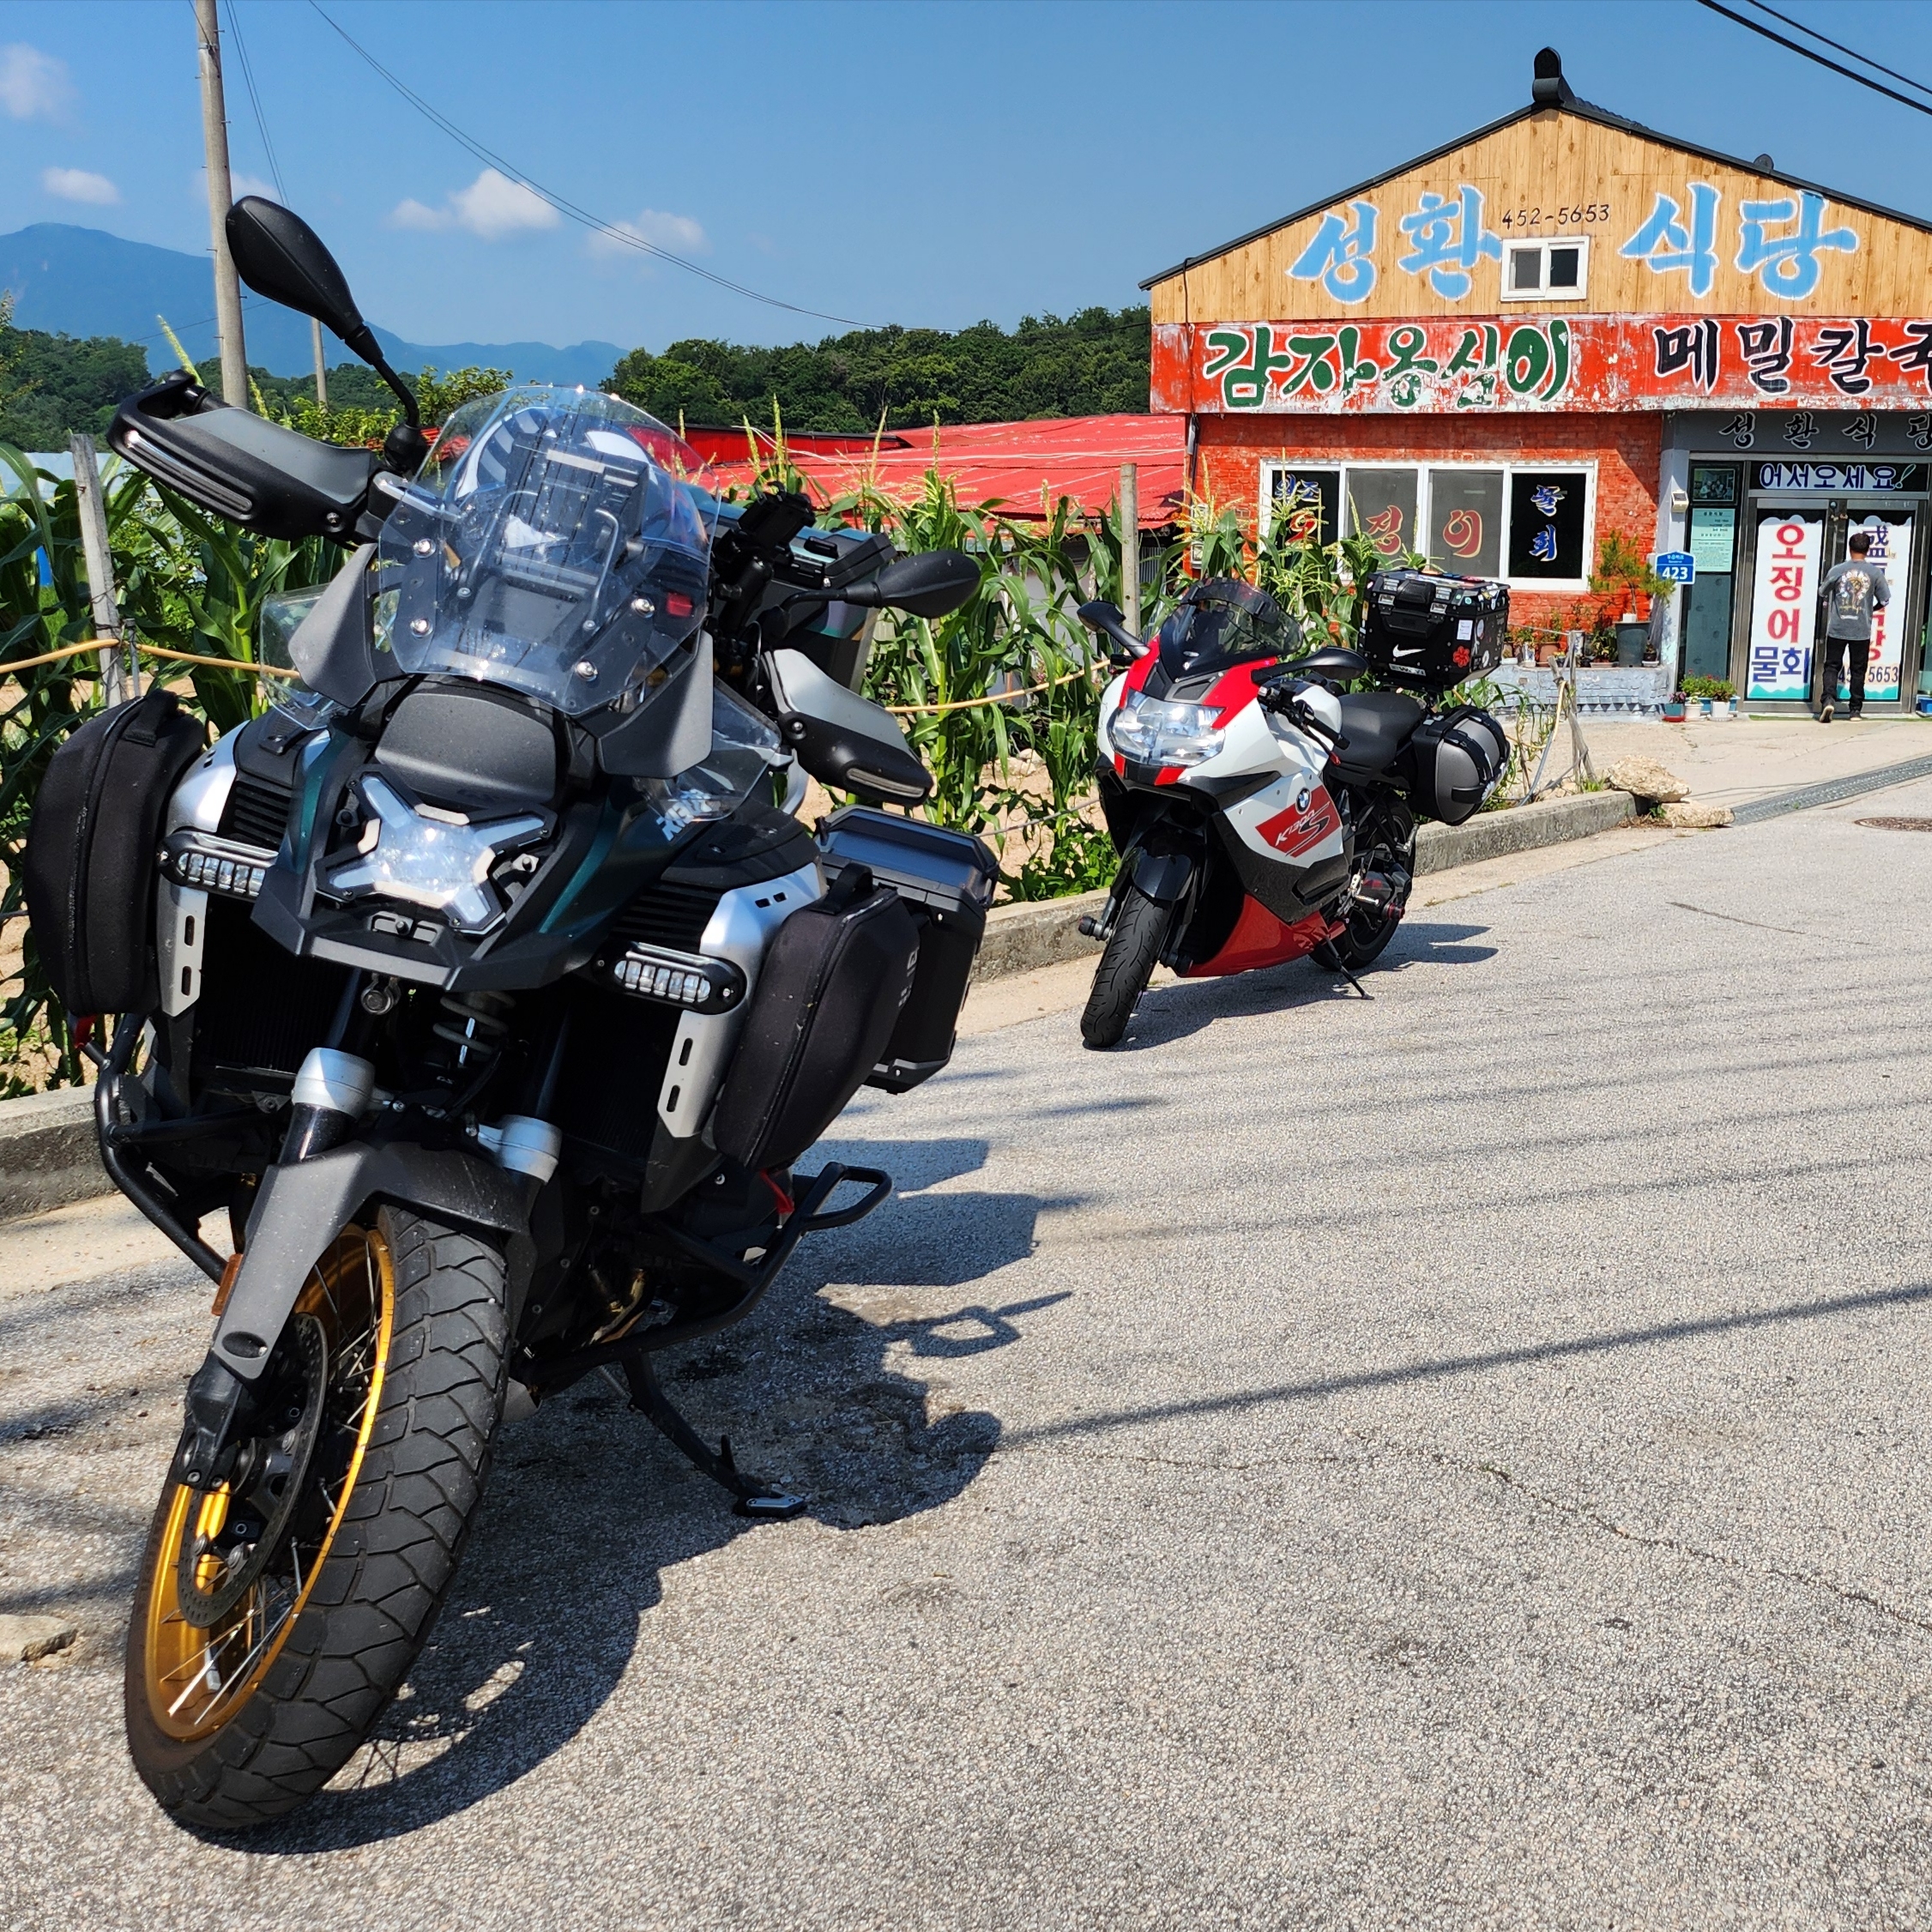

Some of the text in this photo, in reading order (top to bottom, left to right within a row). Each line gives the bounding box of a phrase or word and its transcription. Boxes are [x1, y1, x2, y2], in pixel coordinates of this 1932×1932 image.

[1285, 182, 1859, 305] 성환 식당
[1502, 203, 1610, 230] 452-5653
[1203, 319, 1573, 409] 감자옹심이
[1662, 566, 1688, 580] 423
[1767, 523, 1808, 643] 오징어
[1751, 646, 1812, 684] 물회
